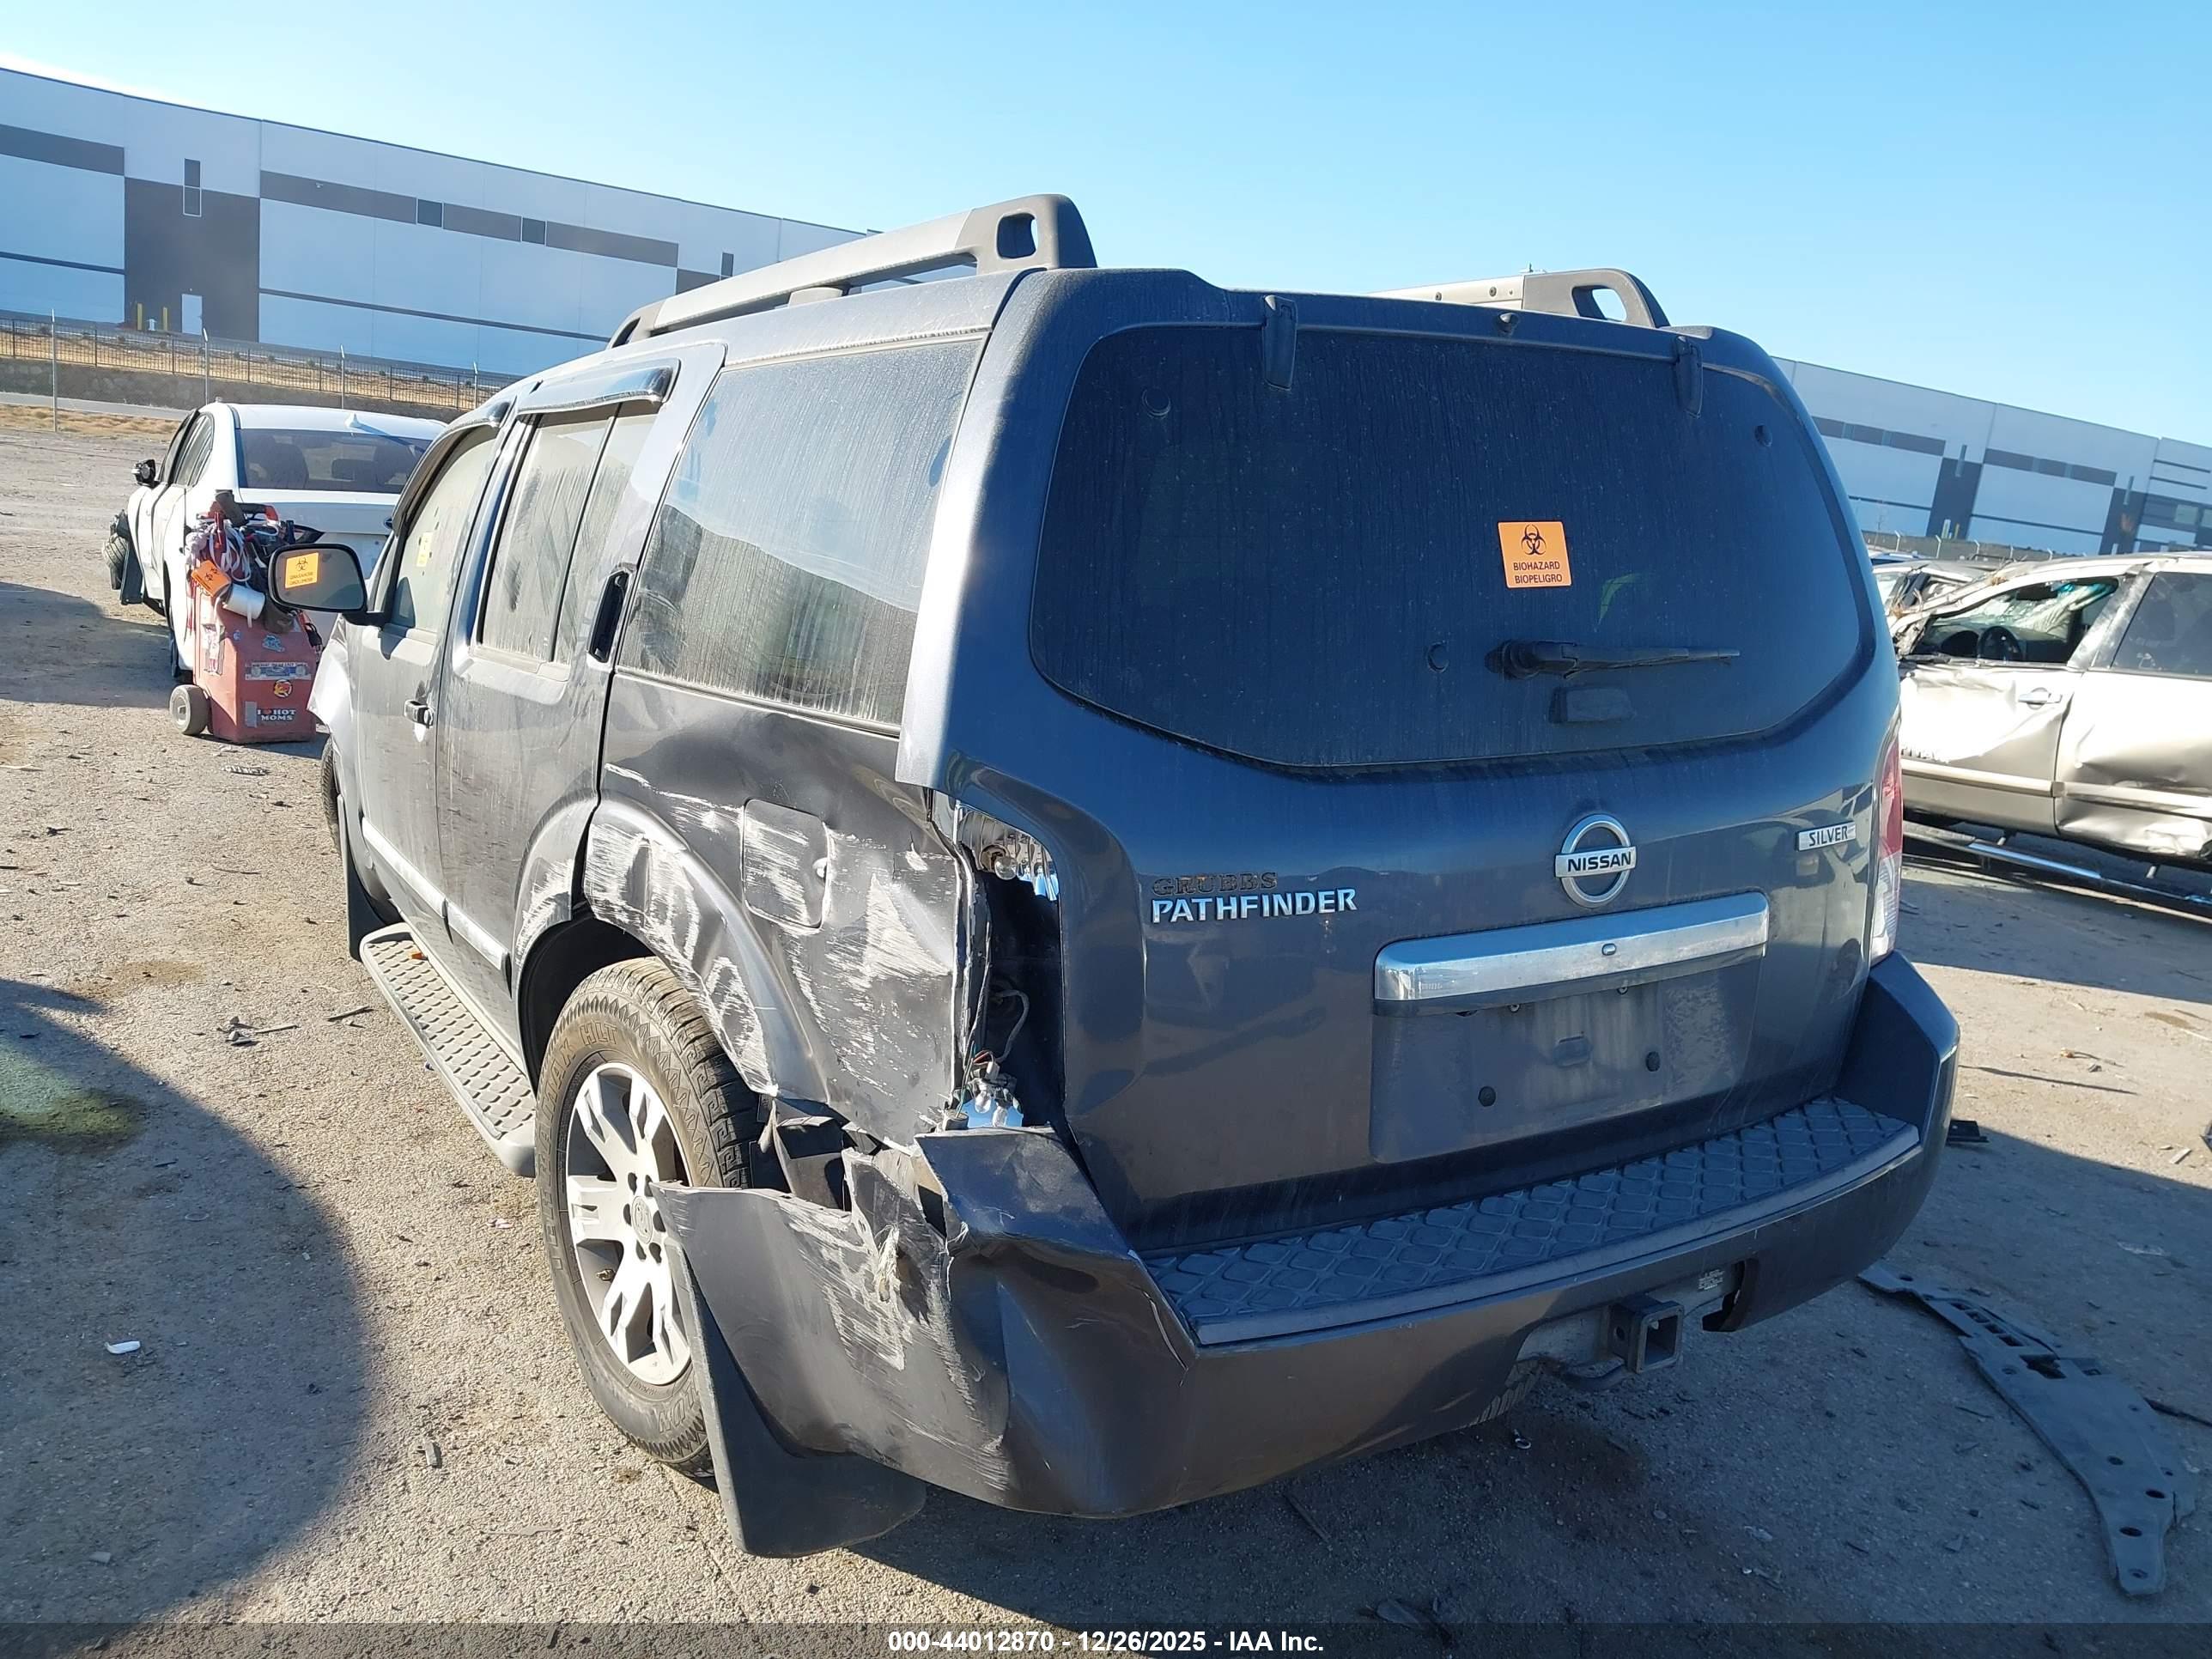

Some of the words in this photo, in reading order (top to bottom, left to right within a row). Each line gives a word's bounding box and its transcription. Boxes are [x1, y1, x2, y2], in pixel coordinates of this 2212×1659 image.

[1513, 561, 1560, 571] BIOHAZARD
[1515, 574, 1563, 584] BIOPELIGRO
[1808, 825, 1849, 847] SILVER
[1567, 851, 1632, 873] NISSAN
[1152, 871, 1278, 896] GRUBBS
[1152, 888, 1358, 924] PATHFINDER
[579, 1021, 618, 1047] HLT
